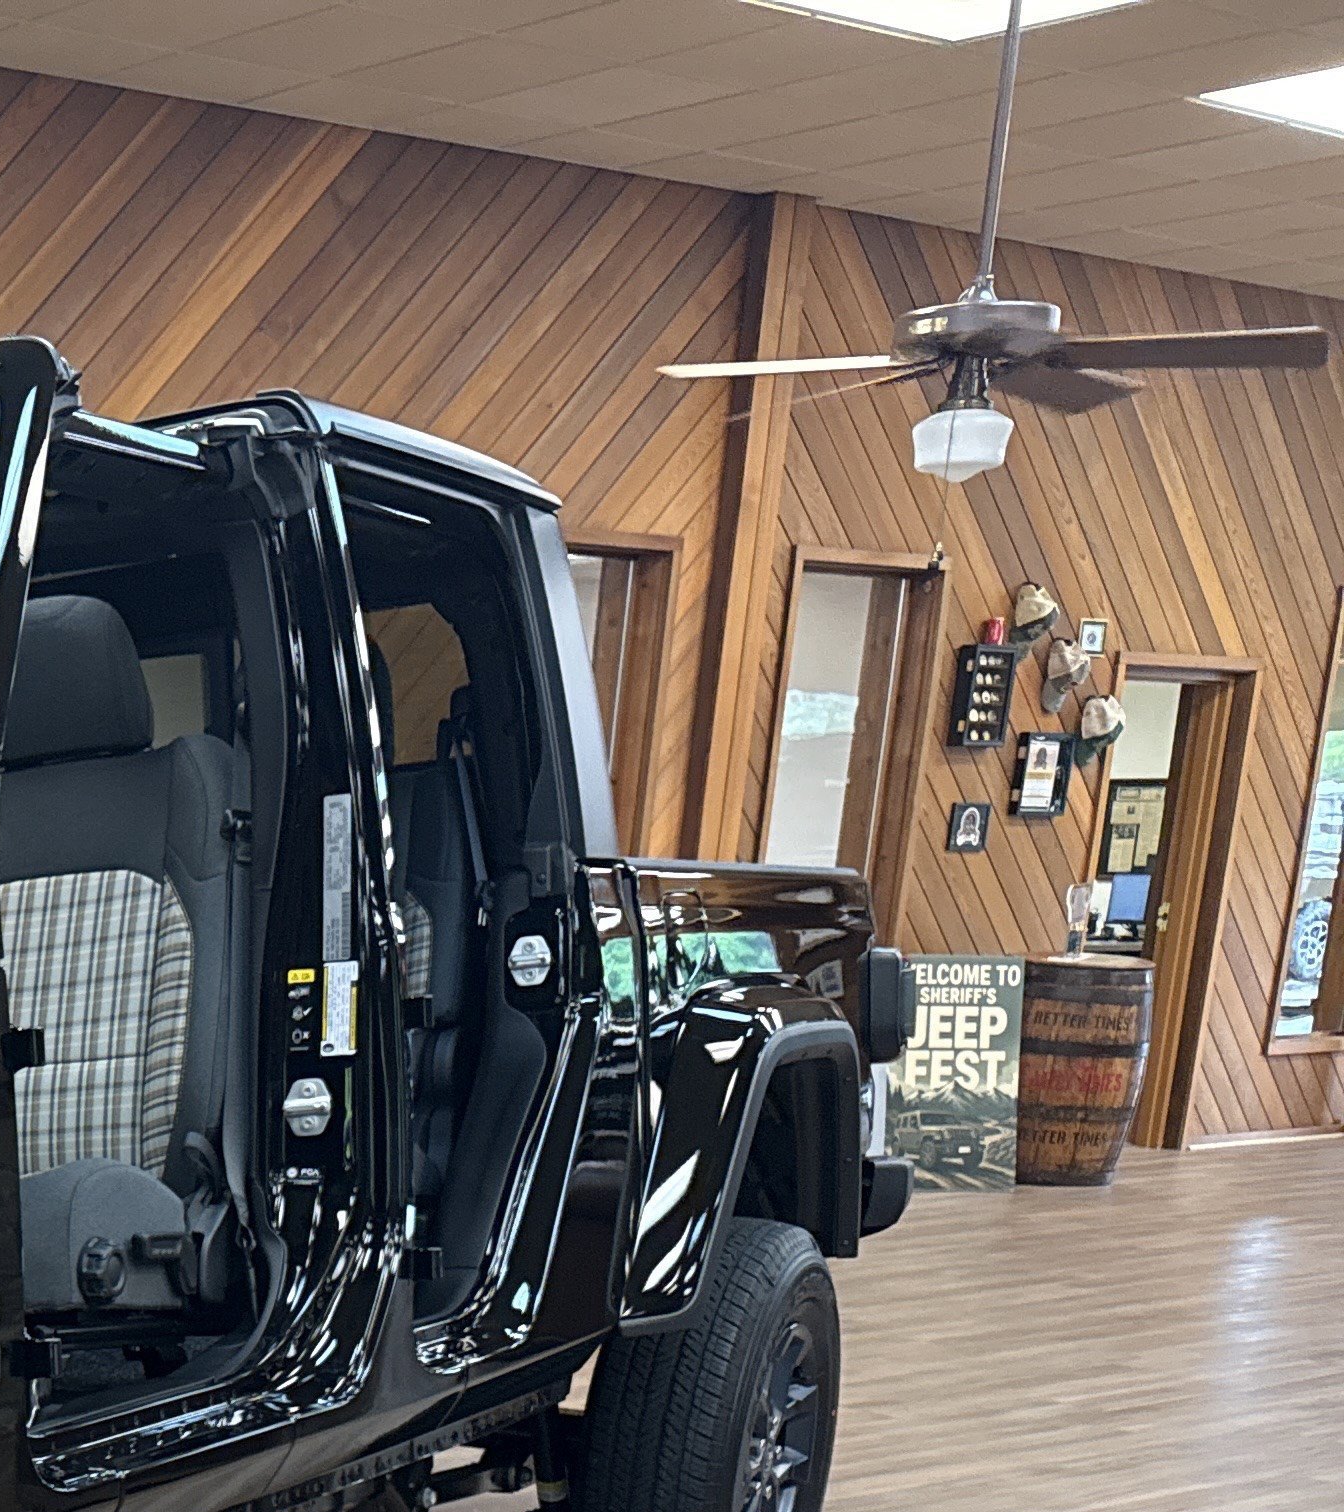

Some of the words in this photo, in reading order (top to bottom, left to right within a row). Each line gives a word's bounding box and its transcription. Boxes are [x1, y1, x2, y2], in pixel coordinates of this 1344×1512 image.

[911, 963, 992, 986] ELCOME
[996, 964, 1021, 987] TO
[919, 987, 997, 1004] SHERIFF'S
[907, 1005, 1008, 1049] JEEP
[1033, 1010, 1088, 1029] BETTER
[1094, 1014, 1130, 1032] TIMES
[904, 1050, 1006, 1090] FEST
